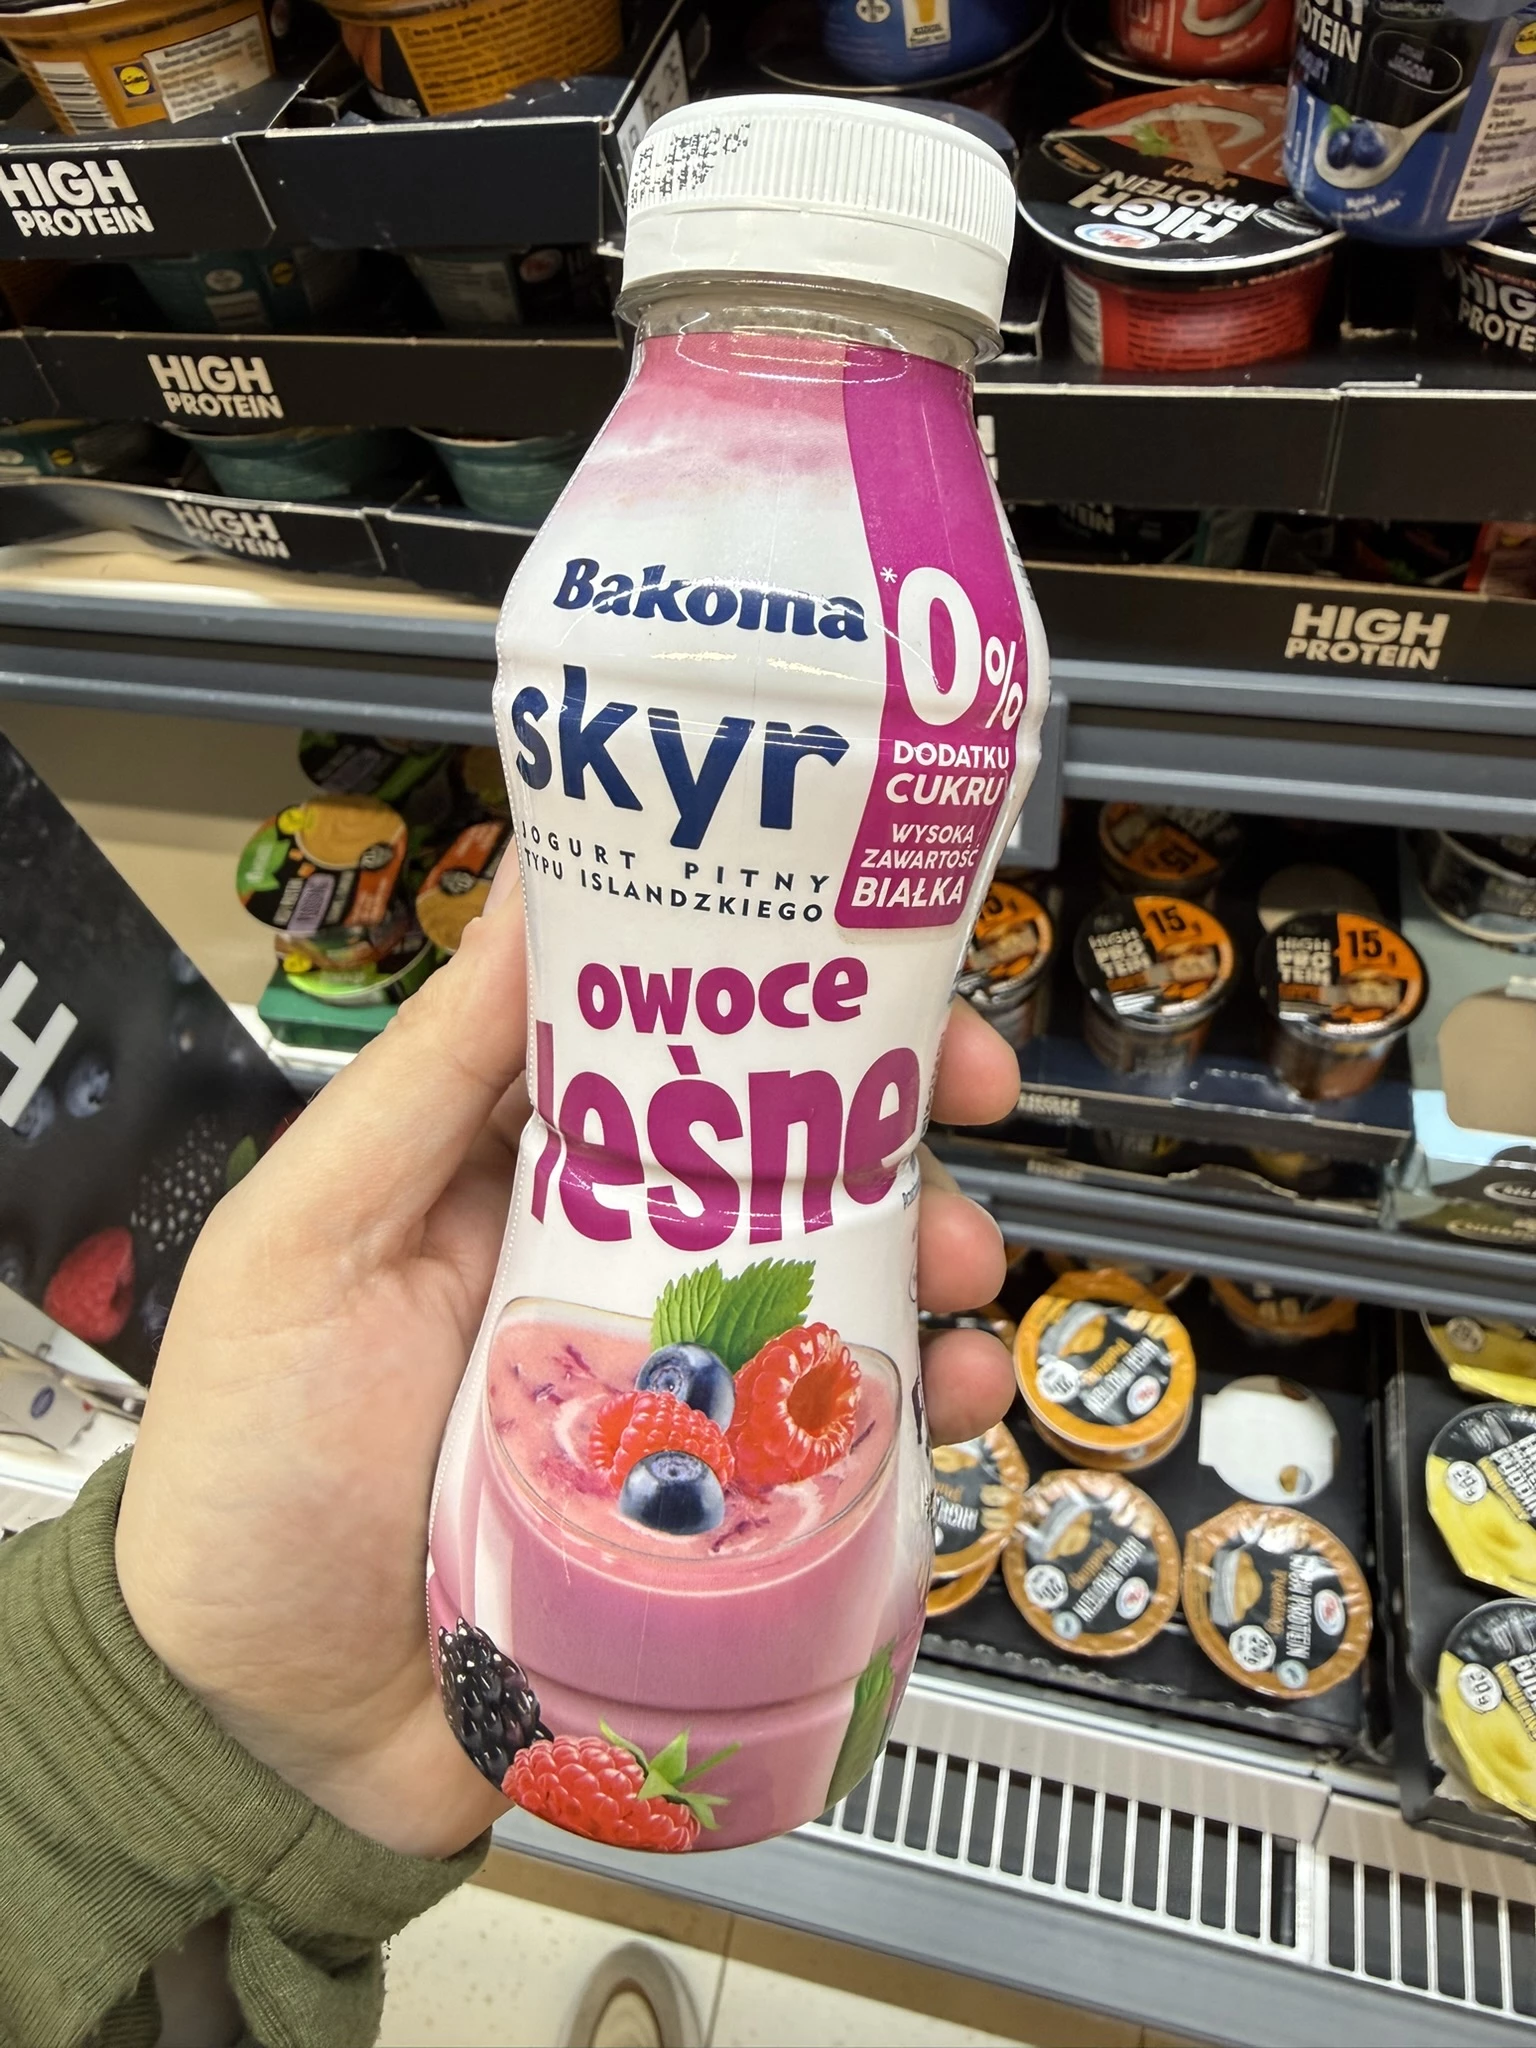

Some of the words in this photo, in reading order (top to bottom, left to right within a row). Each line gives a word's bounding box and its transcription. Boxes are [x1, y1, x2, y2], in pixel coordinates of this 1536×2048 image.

[1299, 3, 1363, 64] OTEIN
[0, 159, 139, 208] HIGH
[1100, 170, 1258, 221] PROTEIN
[12, 205, 154, 237] PROTEIN
[1069, 183, 1238, 244] HIGH
[1457, 262, 1536, 321] HIG
[1458, 296, 1536, 353] PROTE
[148, 354, 274, 396] HIGH
[164, 391, 284, 420] PROTEIN
[165, 499, 280, 541] HIGH
[552, 557, 869, 642] Bakoma
[1291, 603, 1450, 648] HIGH
[1285, 637, 1440, 670] PROTEIN
[510, 664, 850, 851] skyr
[893, 740, 1010, 770] DODATKU
[885, 773, 1005, 807] CUKRU
[860, 839, 980, 870] ZAWARTOŚĆ
[891, 823, 975, 845] WYSOKA
[522, 820, 636, 869] JOGURT
[685, 862, 830, 895] PITNY
[524, 847, 563, 881] TYPU
[581, 868, 824, 923] ISLANDZKIEGO
[851, 875, 966, 910] BIAŁKA
[1147, 905, 1187, 934] 15
[1346, 930, 1383, 959] 15
[577, 957, 869, 1035] owoce
[530, 1018, 921, 1252] leśne
